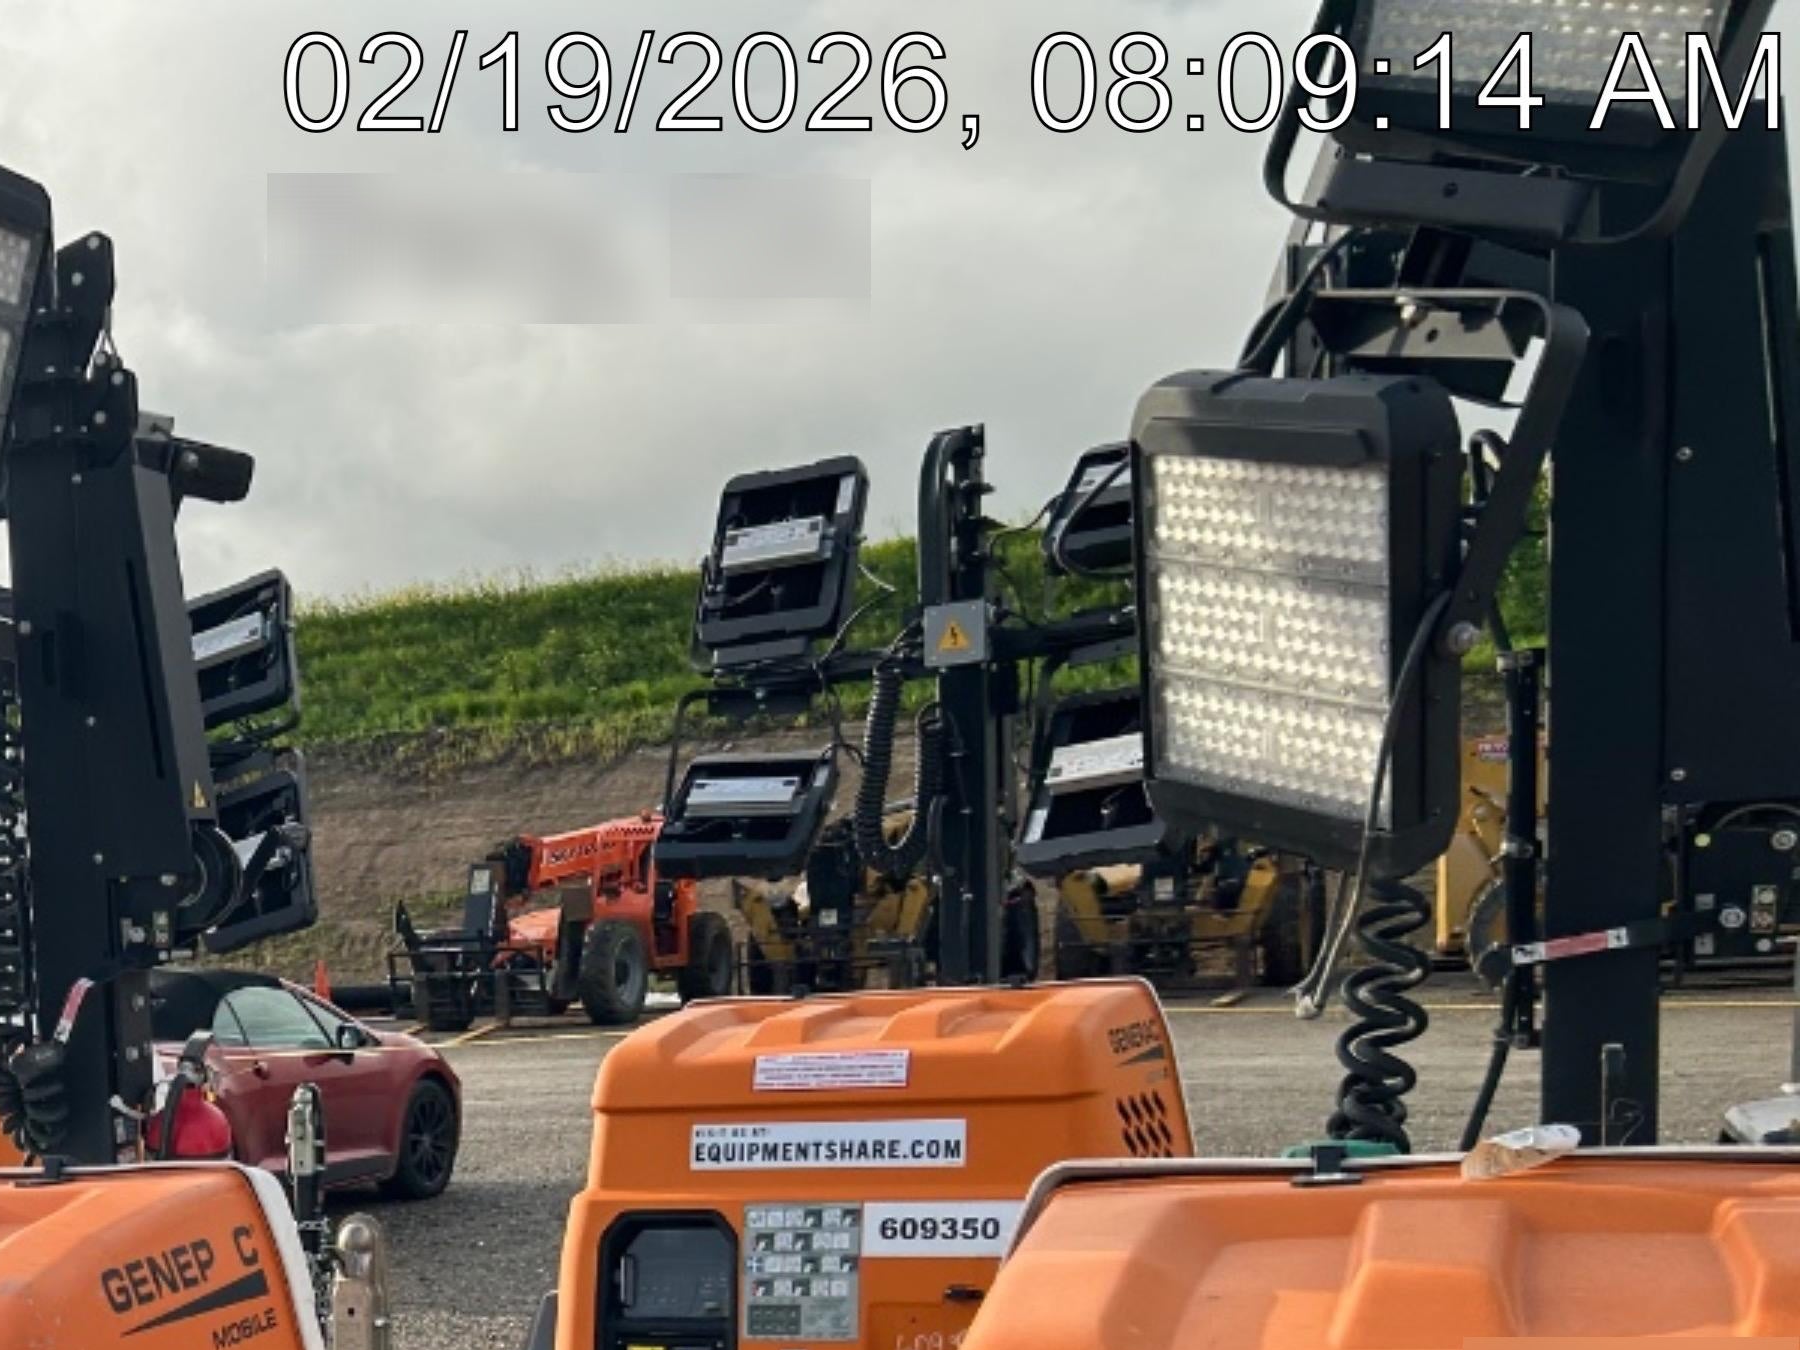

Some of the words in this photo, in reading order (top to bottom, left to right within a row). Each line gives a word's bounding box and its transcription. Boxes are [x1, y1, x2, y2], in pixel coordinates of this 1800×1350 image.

[694, 1139, 961, 1164] EQUIPMENTSHARE.COM
[879, 1216, 1001, 1240] 609350
[211, 1307, 278, 1350] MOBILE
